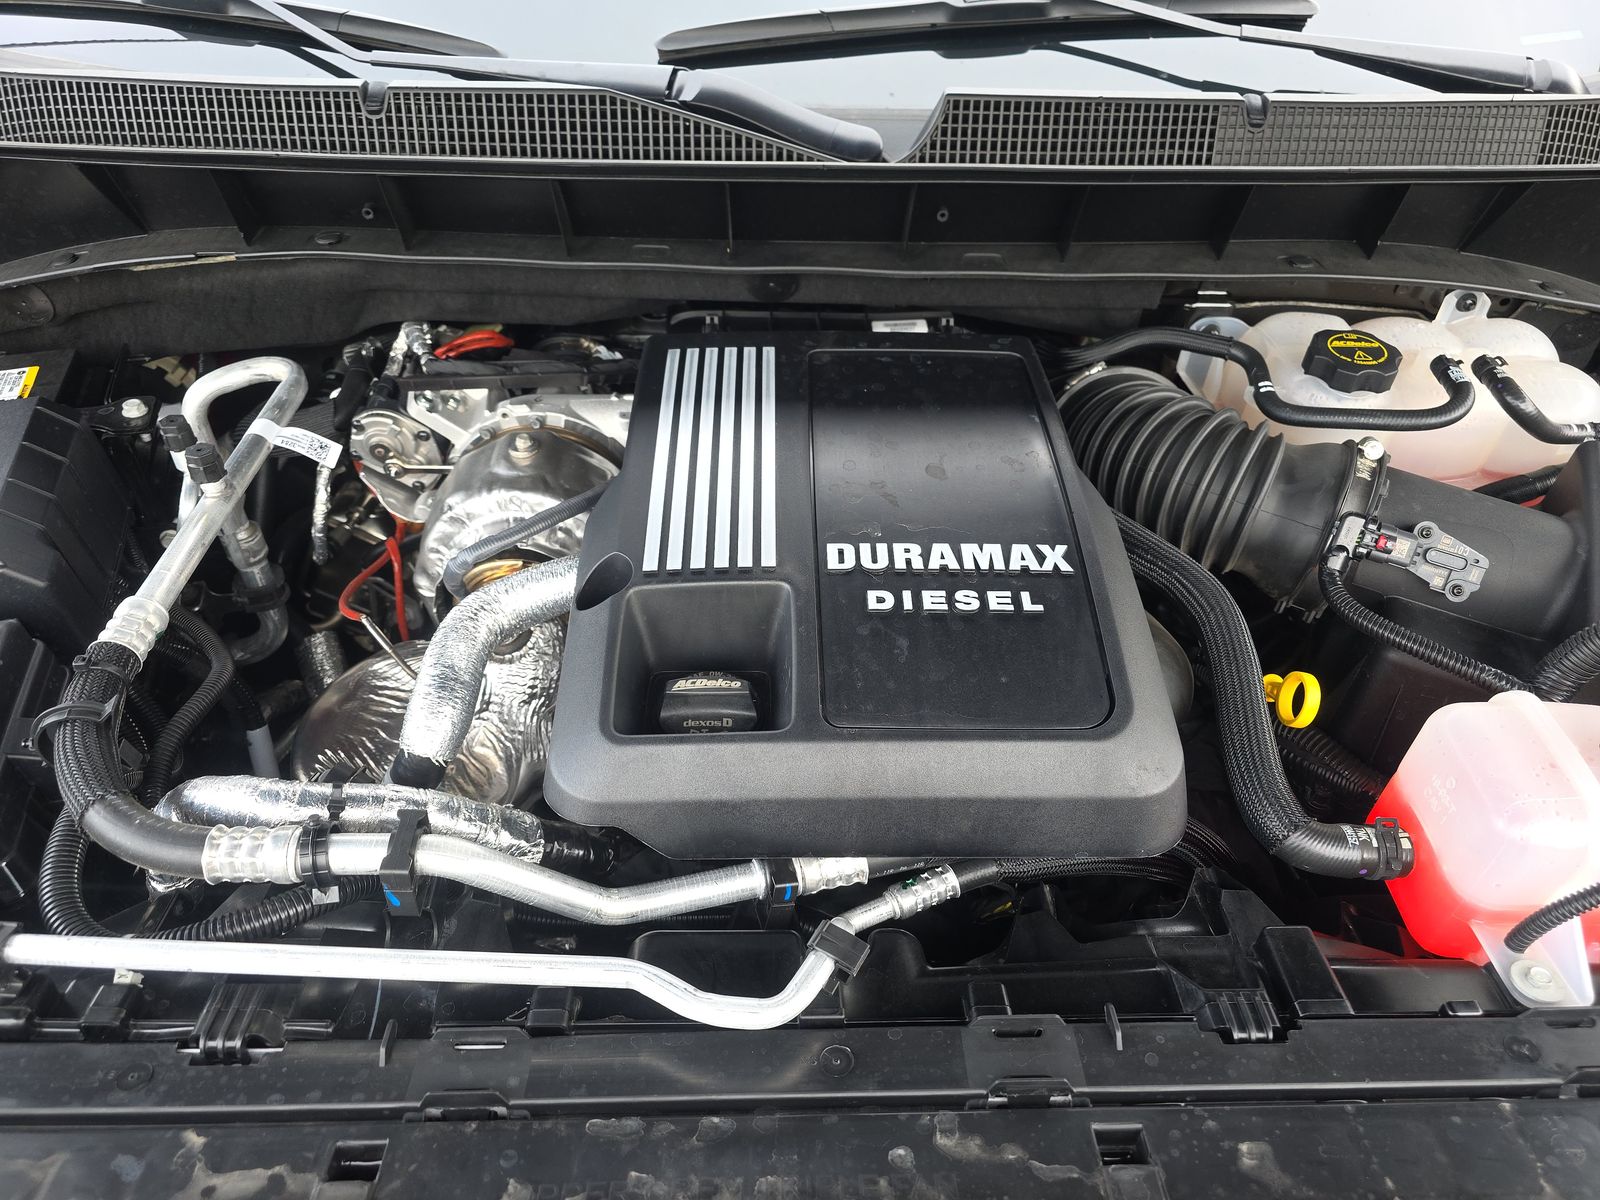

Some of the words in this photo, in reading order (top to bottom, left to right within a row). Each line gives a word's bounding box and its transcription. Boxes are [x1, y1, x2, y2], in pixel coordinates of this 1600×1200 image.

[826, 543, 1074, 574] DURAMAX
[866, 589, 1044, 613] DIESEL
[672, 678, 742, 689] ACDelco
